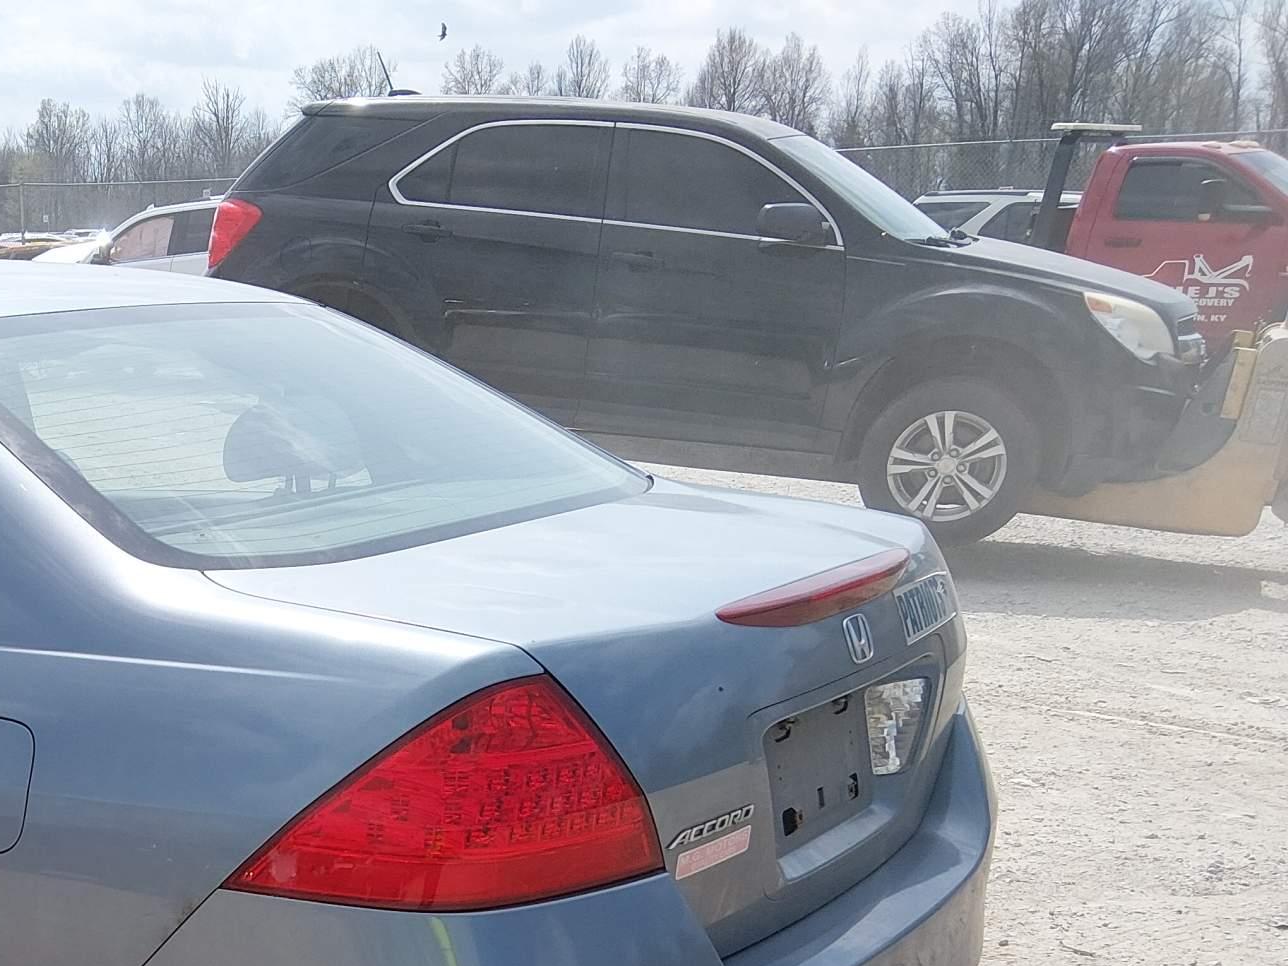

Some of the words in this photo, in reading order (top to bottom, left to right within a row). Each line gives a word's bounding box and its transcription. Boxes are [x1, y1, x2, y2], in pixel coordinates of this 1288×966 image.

[1204, 286, 1240, 298] J'S
[1210, 314, 1227, 322] KY
[666, 804, 754, 850] ACCORD
